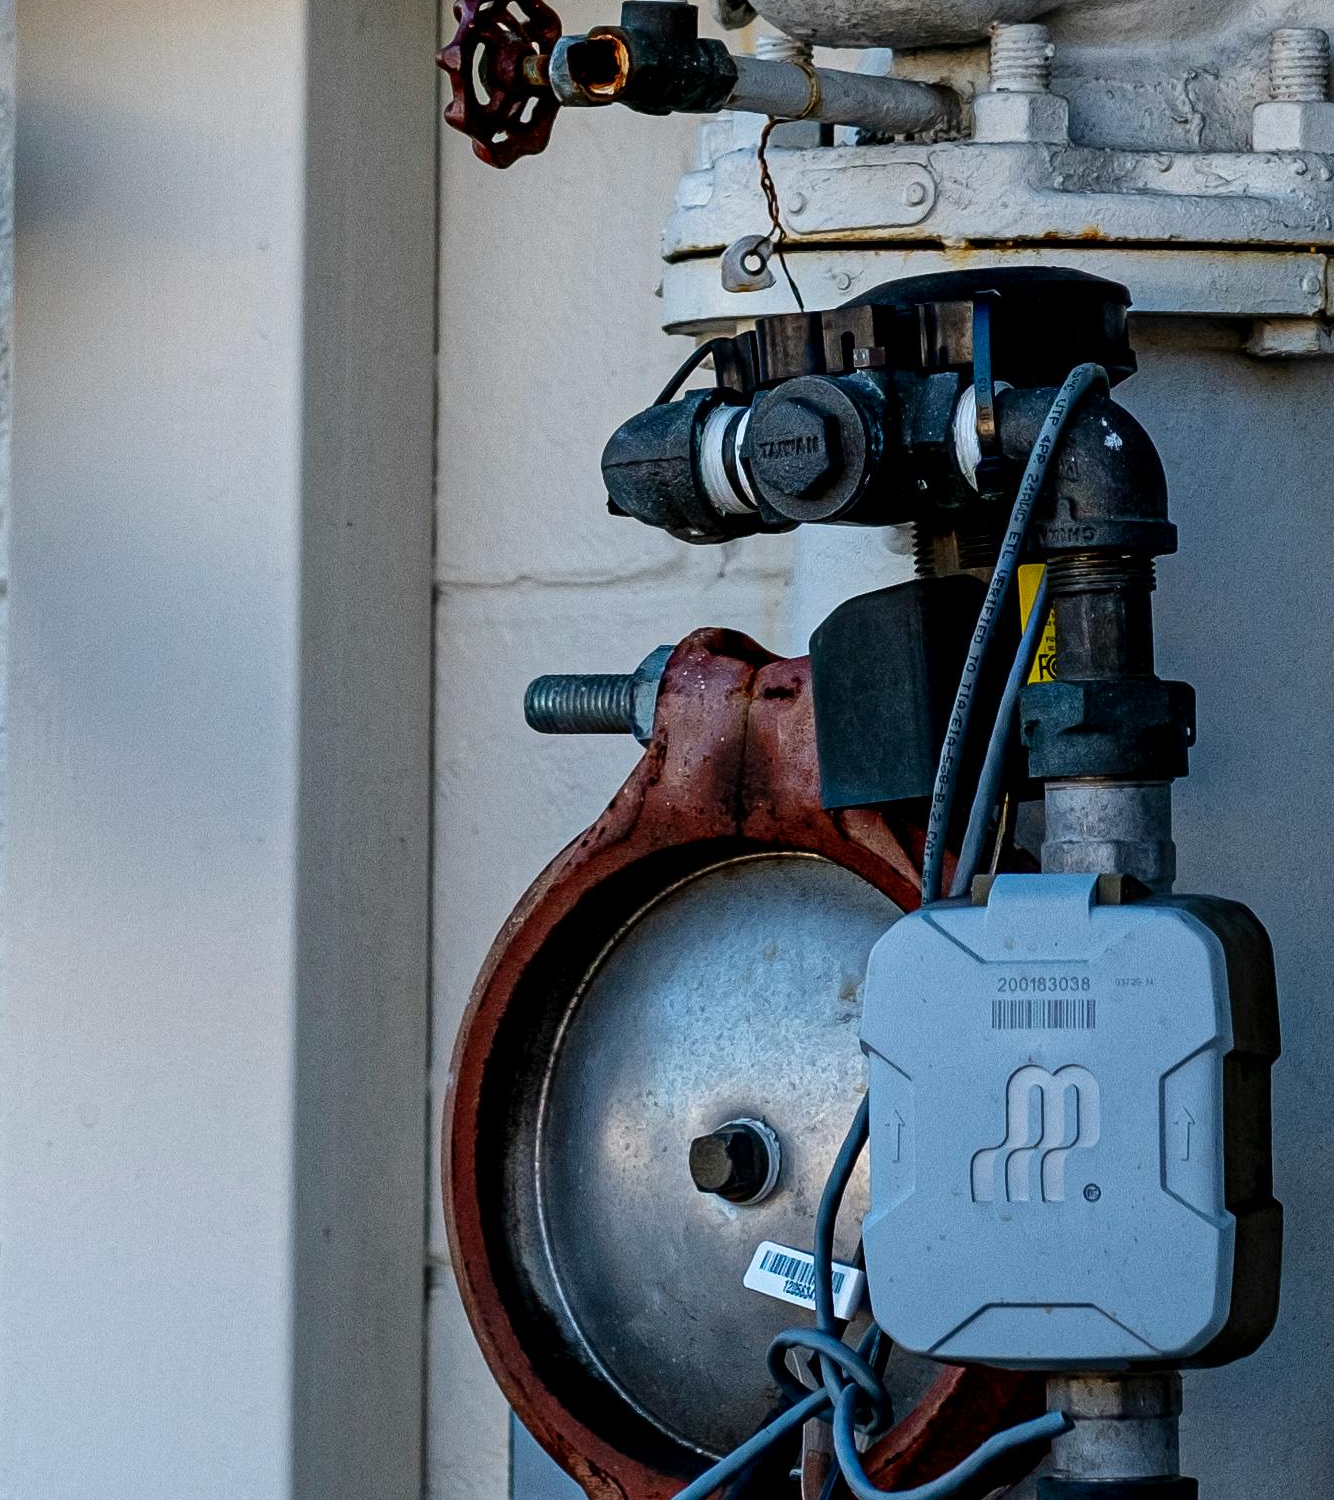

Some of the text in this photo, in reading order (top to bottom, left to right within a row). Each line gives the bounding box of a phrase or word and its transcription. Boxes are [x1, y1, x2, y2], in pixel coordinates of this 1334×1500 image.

[1051, 397, 1068, 427] UTP
[973, 568, 1010, 646] VERIFIED
[966, 654, 980, 674] TO
[997, 976, 1092, 993] 200183038
